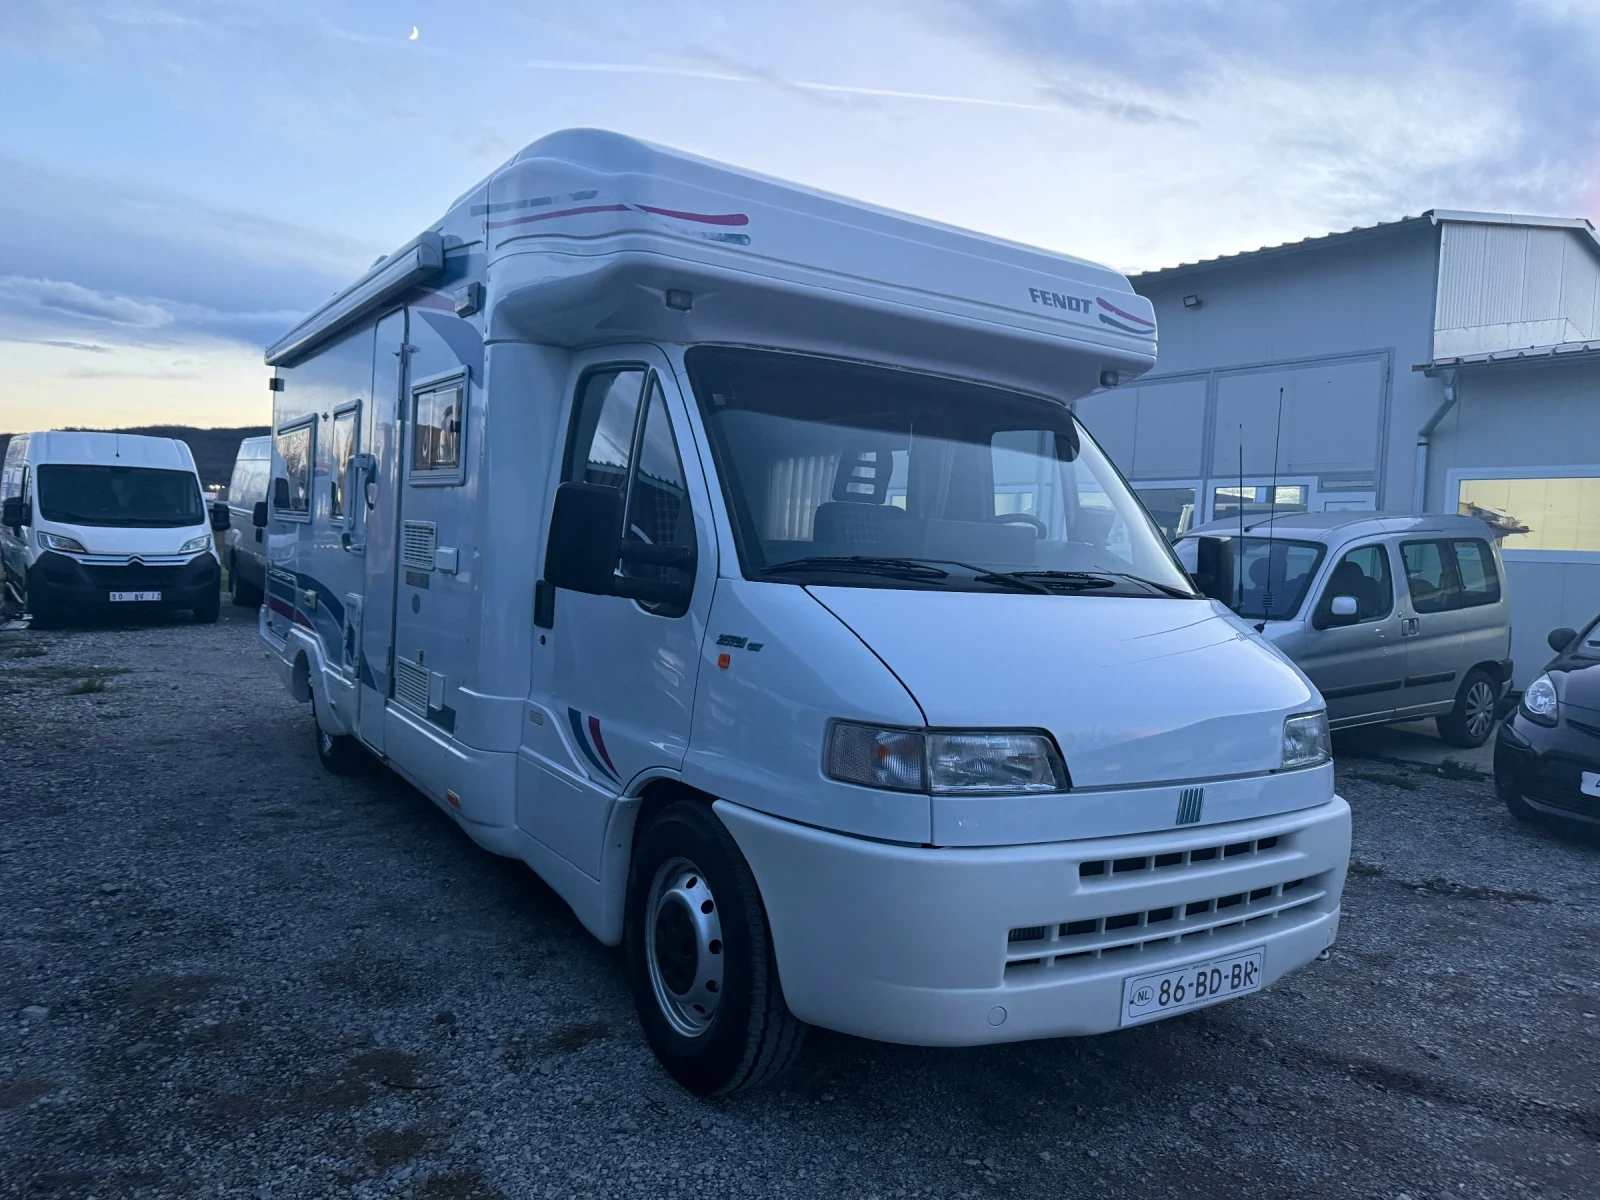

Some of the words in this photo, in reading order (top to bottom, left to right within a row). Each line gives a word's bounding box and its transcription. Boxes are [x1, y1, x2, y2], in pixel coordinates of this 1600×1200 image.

[1028, 287, 1093, 314] FENDT
[1137, 990, 1150, 1002] NL
[1158, 960, 1255, 1007] 86-BD-BR
